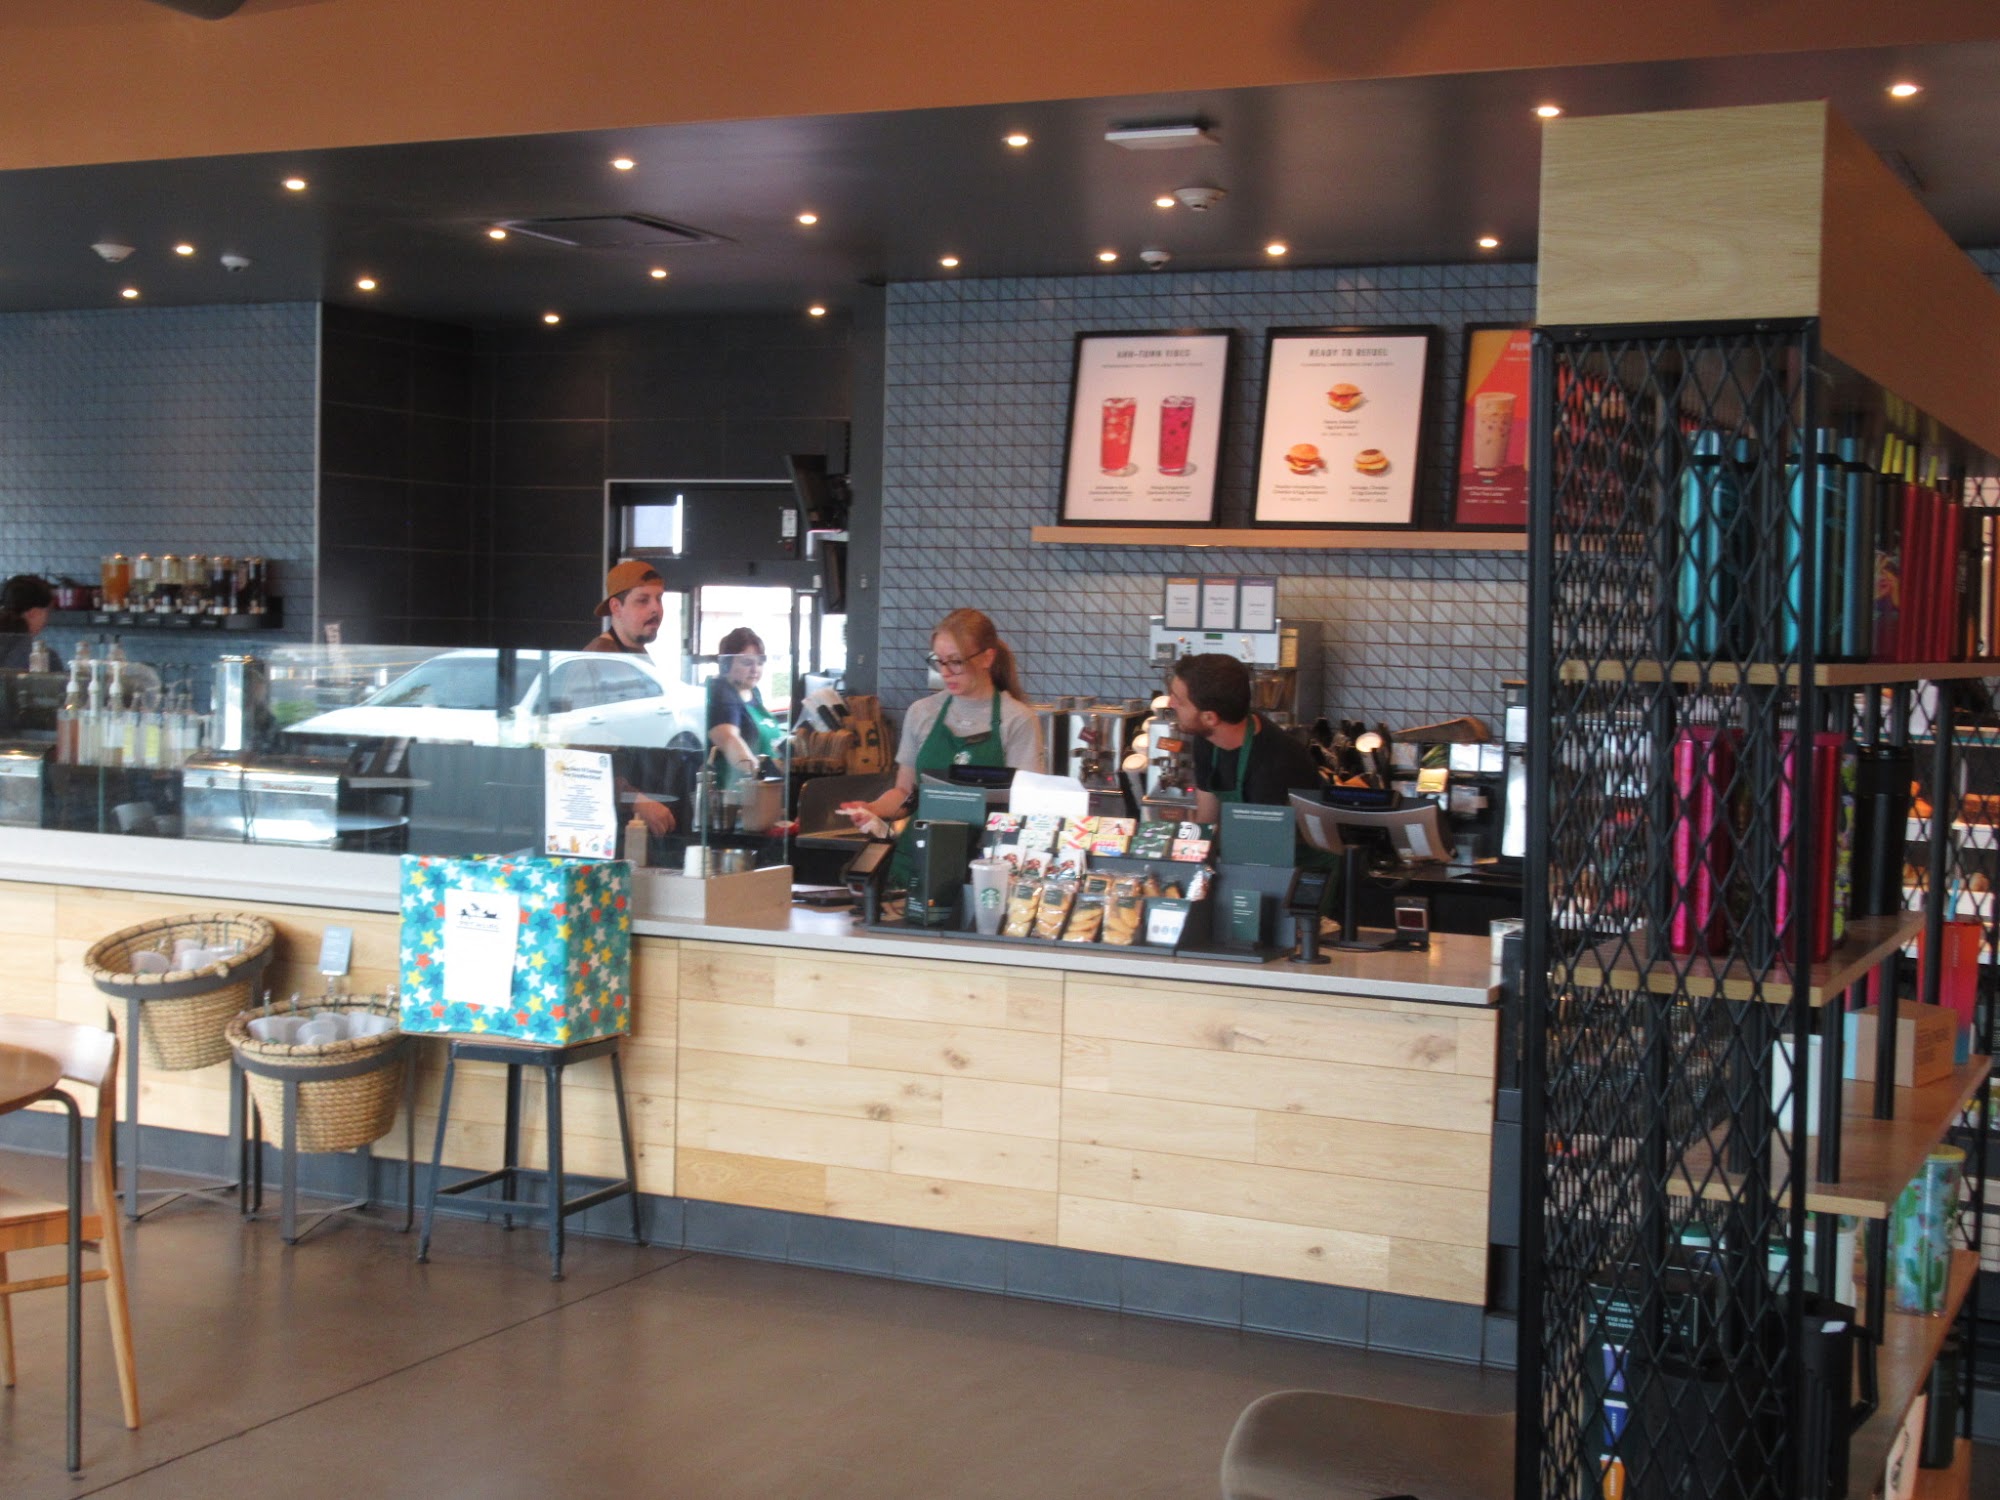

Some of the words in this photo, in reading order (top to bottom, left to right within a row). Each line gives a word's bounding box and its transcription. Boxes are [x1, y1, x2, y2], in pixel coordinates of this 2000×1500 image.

[1309, 349, 1338, 357] READY
[1342, 349, 1352, 357] TO
[1356, 348, 1388, 357] REFUEL
